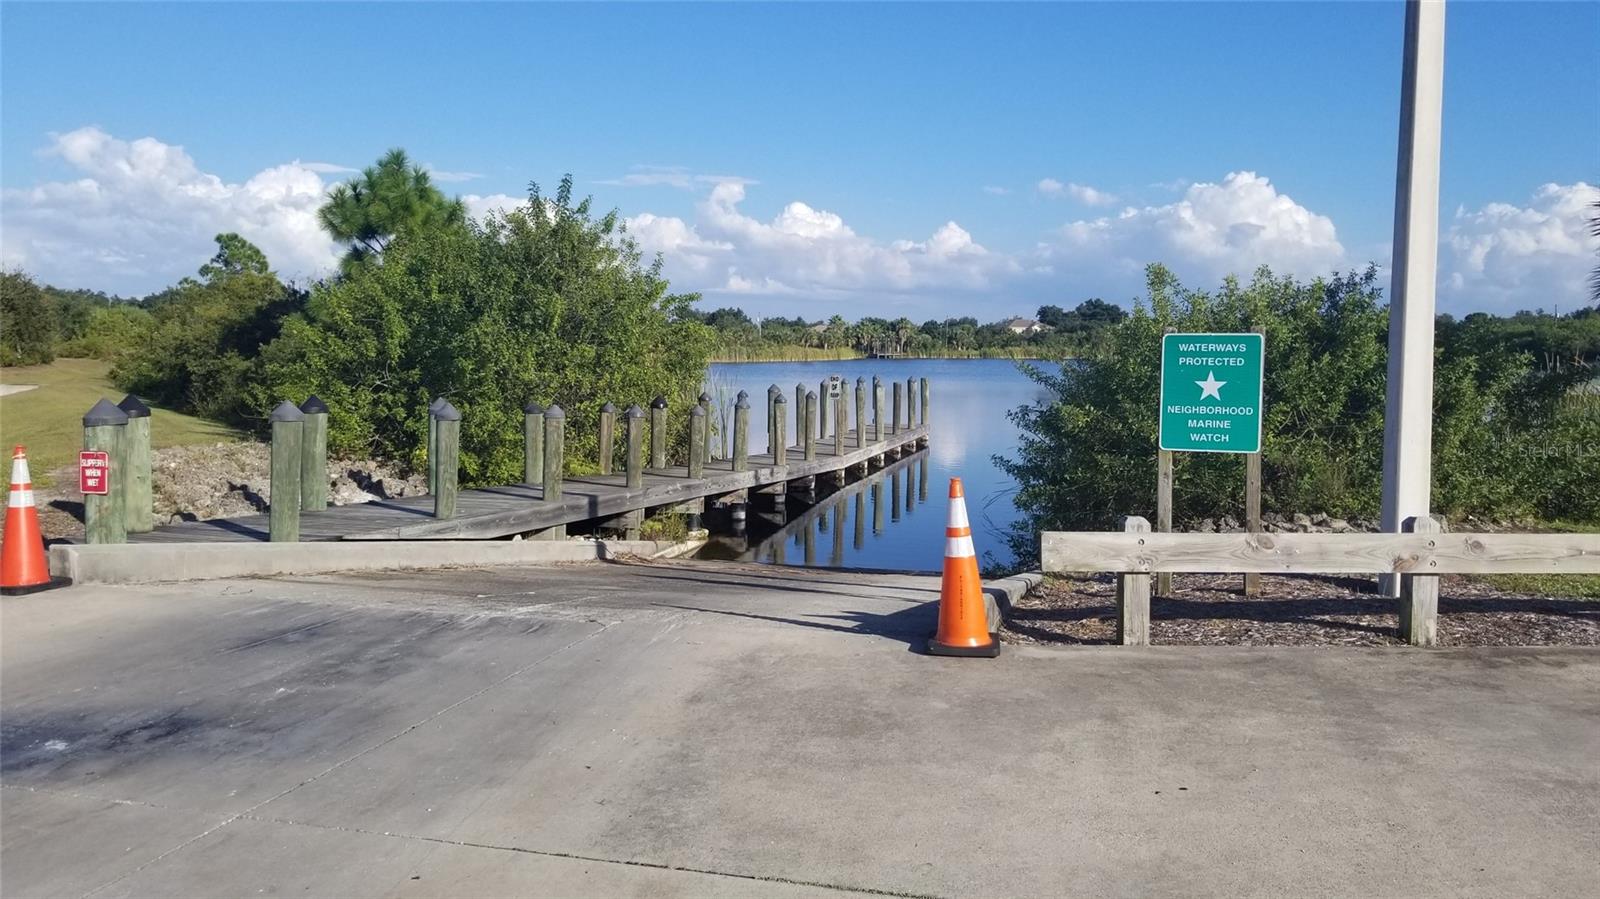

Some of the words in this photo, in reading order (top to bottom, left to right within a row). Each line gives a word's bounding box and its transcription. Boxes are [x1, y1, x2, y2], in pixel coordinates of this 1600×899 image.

[1178, 343, 1247, 352] WATERWAYS
[1178, 357, 1245, 366] PROTECTED
[1167, 405, 1254, 416] NEIGHBORHOOD
[1187, 419, 1232, 429] MARINE
[1190, 433, 1230, 443] WATCH
[85, 469, 102, 477] WHEN
[87, 478, 99, 486] WET
